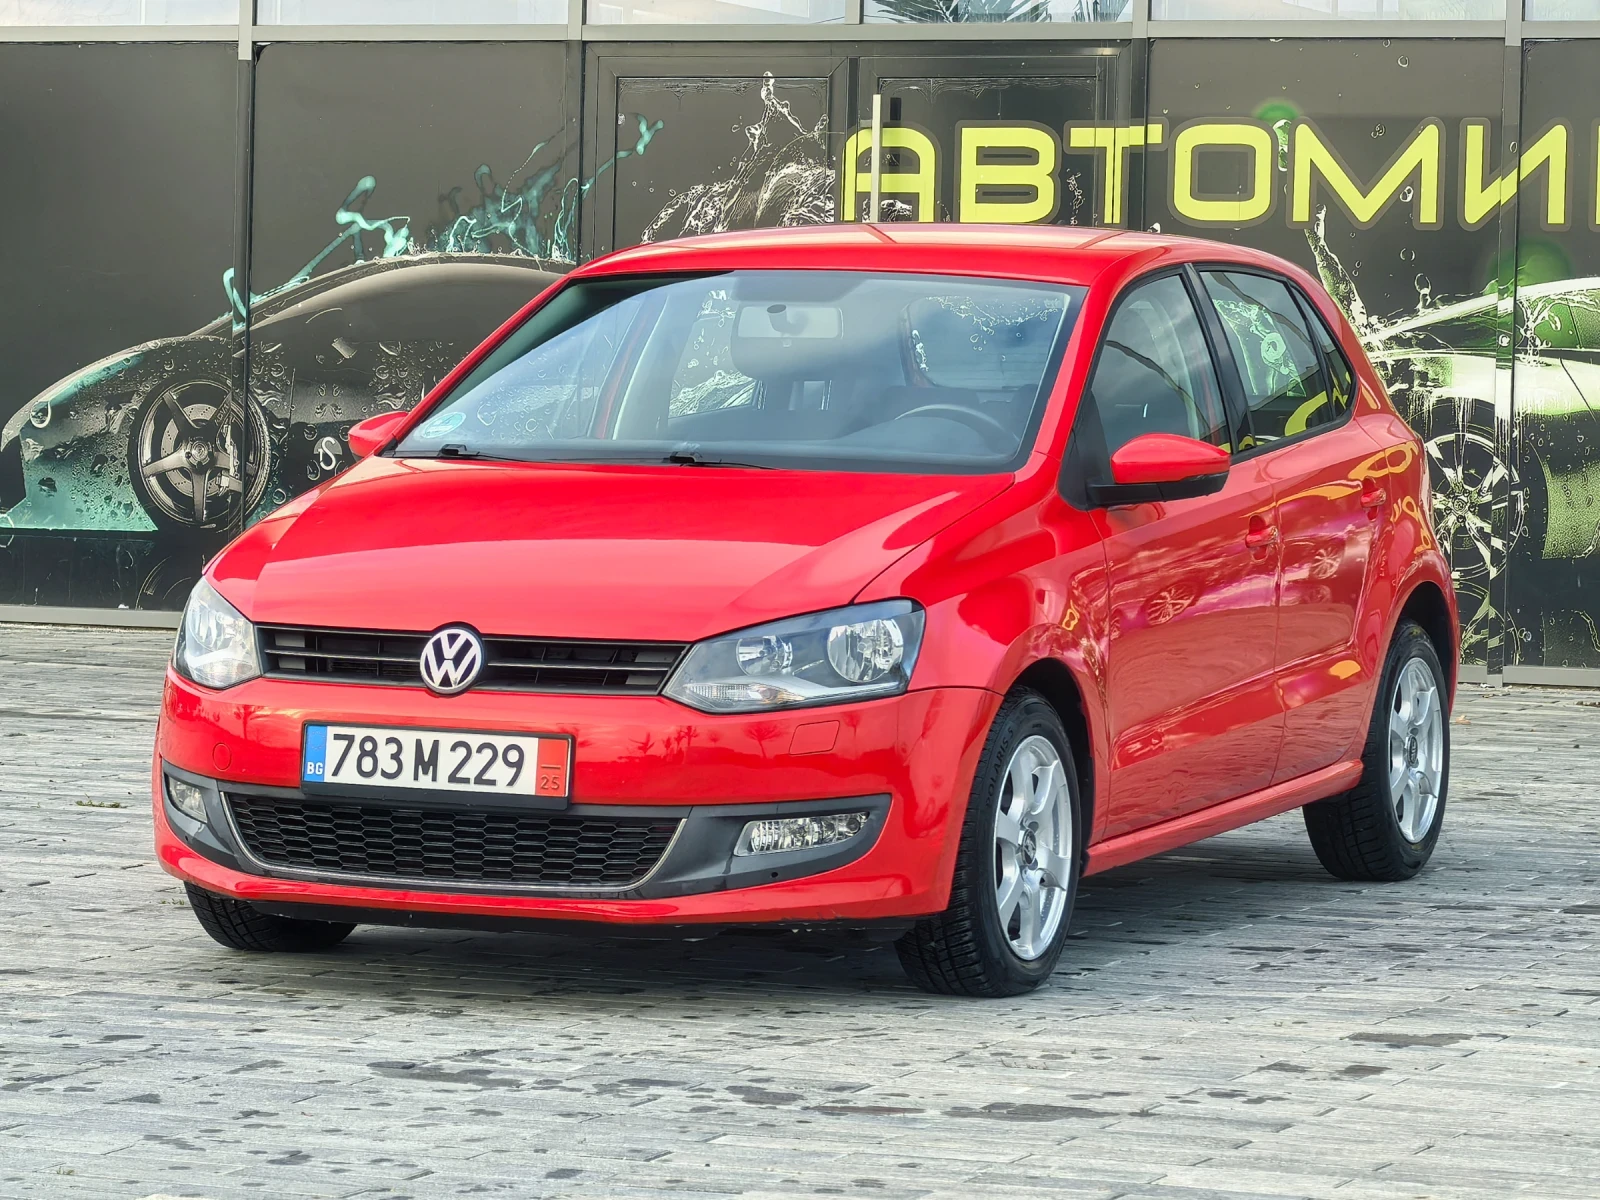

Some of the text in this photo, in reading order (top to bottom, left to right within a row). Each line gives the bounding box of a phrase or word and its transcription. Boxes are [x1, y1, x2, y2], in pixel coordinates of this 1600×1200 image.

[842, 123, 1600, 225] АВТОМИ
[420, 628, 483, 692] VW
[306, 761, 324, 776] BG
[331, 733, 525, 787] 783 M 229
[540, 774, 560, 790] 25
